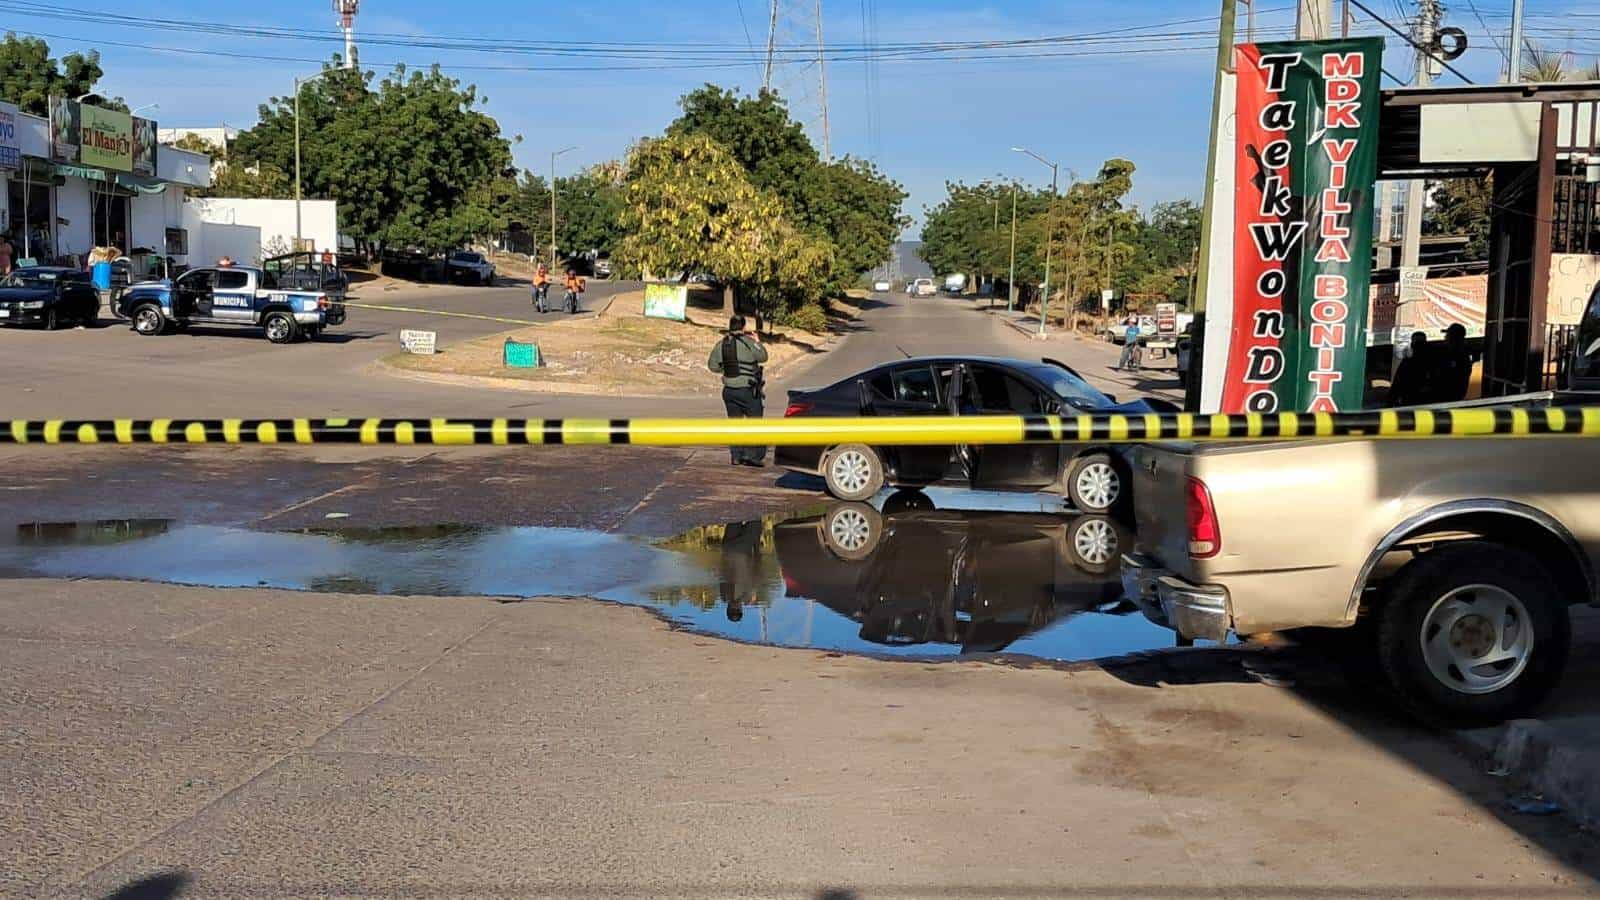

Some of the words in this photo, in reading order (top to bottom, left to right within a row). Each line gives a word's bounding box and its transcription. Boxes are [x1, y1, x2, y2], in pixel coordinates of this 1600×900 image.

[1322, 53, 1364, 128] MDK
[1314, 139, 1358, 262] VILLA
[213, 295, 249, 307] MUNICIPAL
[1307, 275, 1349, 413] BONITA
